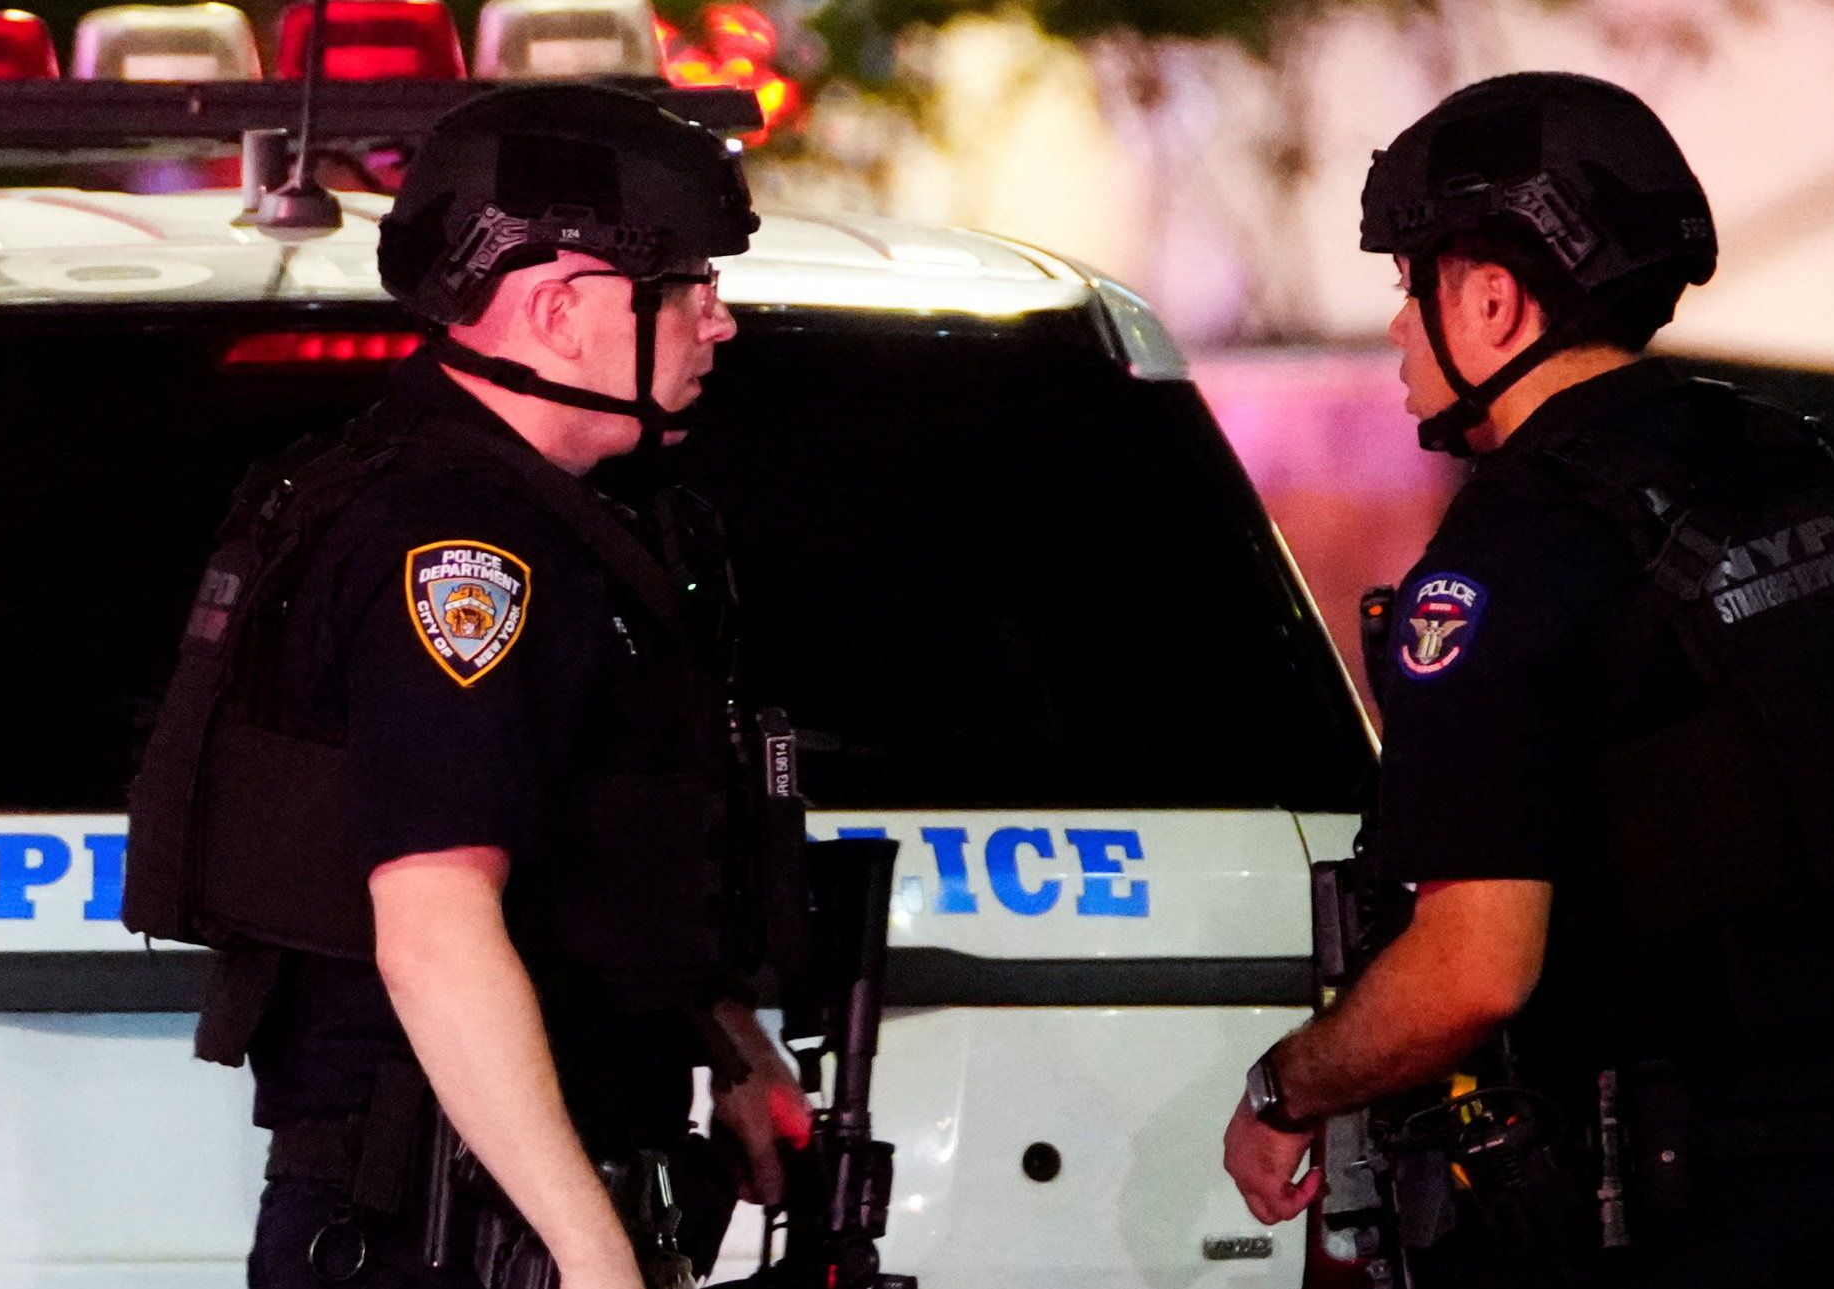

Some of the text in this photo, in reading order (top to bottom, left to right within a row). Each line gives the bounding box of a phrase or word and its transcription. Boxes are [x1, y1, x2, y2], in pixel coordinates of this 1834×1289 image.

[418, 562, 521, 596] DEPARTMENT
[442, 549, 503, 571] POLICE
[1416, 579, 1478, 608] POLICE
[417, 599, 454, 658] CITY OF
[473, 603, 522, 668] NEW YORK
[835, 825, 1151, 919] ICE
